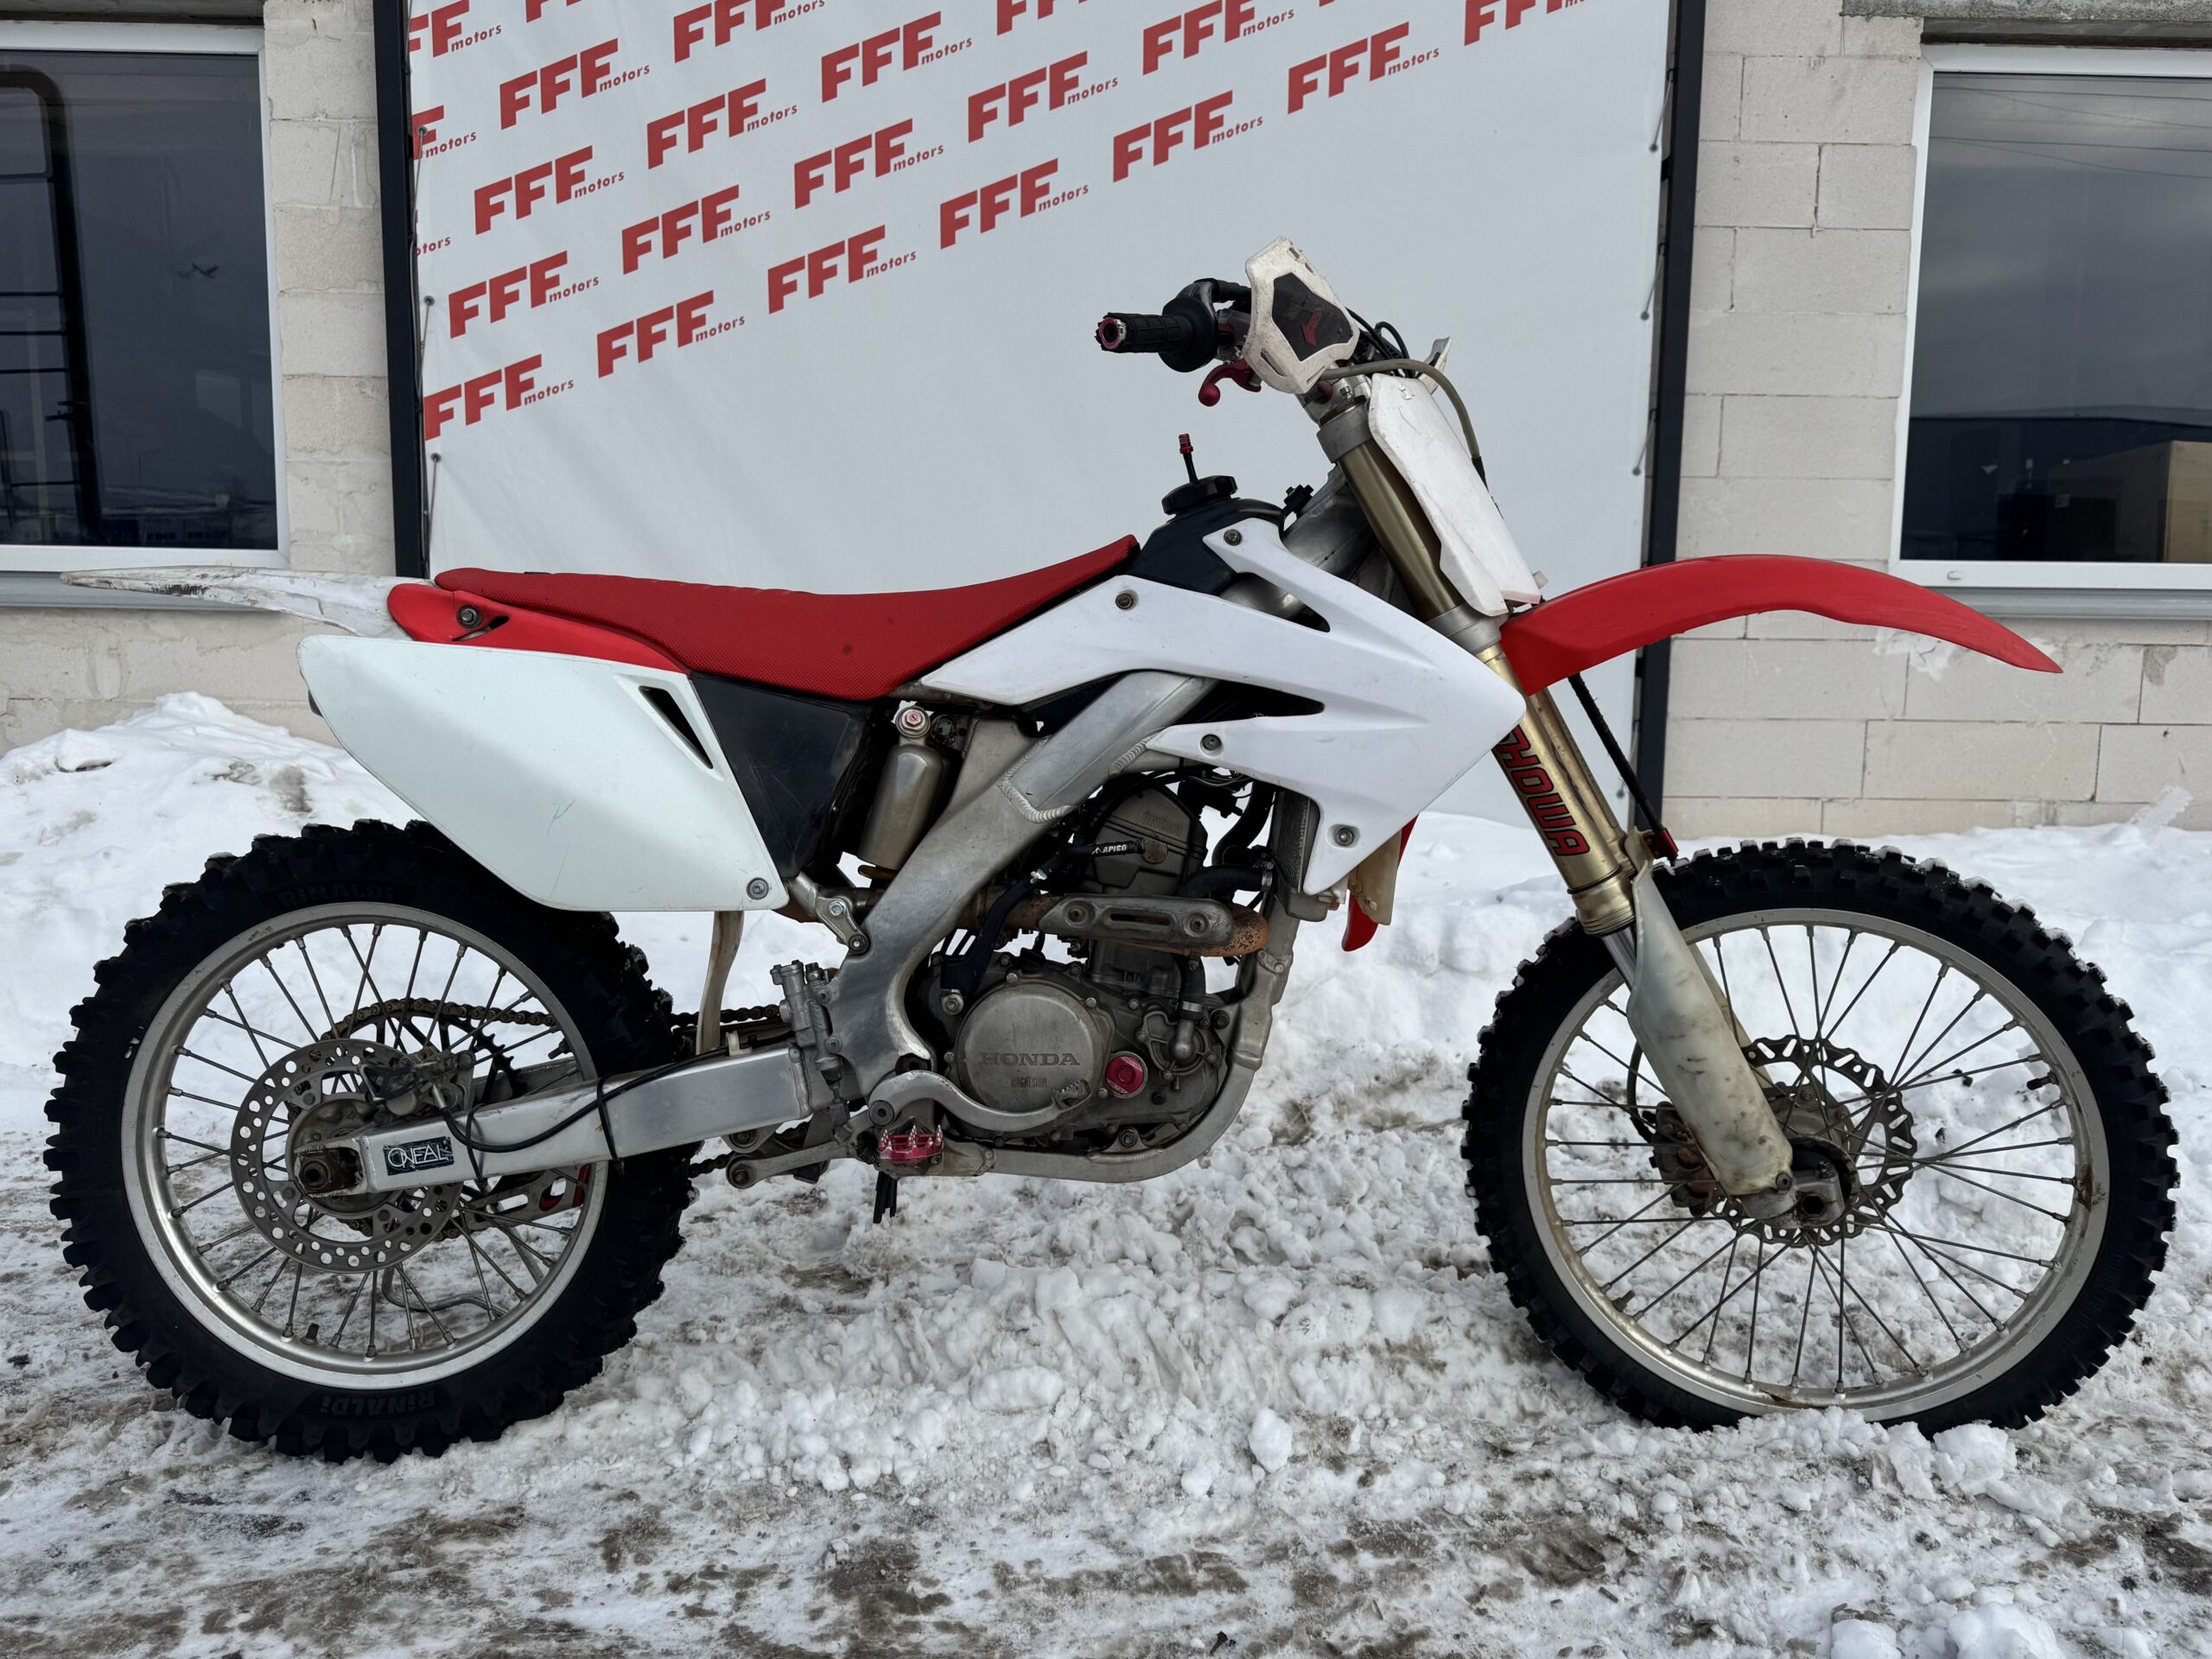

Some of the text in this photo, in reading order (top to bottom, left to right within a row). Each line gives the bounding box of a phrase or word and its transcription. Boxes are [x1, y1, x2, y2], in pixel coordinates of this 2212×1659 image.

[451, 25, 502, 52] motors
[774, 0, 825, 25] motors
[1142, 0, 1255, 74] FFF
[1243, 10, 1294, 37] motors
[499, 39, 650, 129] FFF motors
[821, 12, 940, 102] FFF
[921, 38, 972, 65] motors
[968, 52, 1118, 142] FFF motors
[1288, 22, 1409, 114] FFF
[1388, 48, 1440, 75] motors
[426, 131, 476, 158] motors
[647, 79, 798, 168] FFF motors
[794, 119, 944, 208] FFF motors
[1114, 92, 1262, 182] FFF motors
[474, 146, 624, 235] FFF motors
[622, 186, 770, 275] FFF motors
[940, 159, 1088, 249] FFF motors
[448, 251, 600, 338] FFF motors
[767, 226, 916, 314] FFF motors
[597, 290, 745, 378] FFF motors
[423, 355, 574, 441] FFF motors
[1103, 844, 1127, 854] APICO
[979, 1052, 1081, 1066] HONDA
